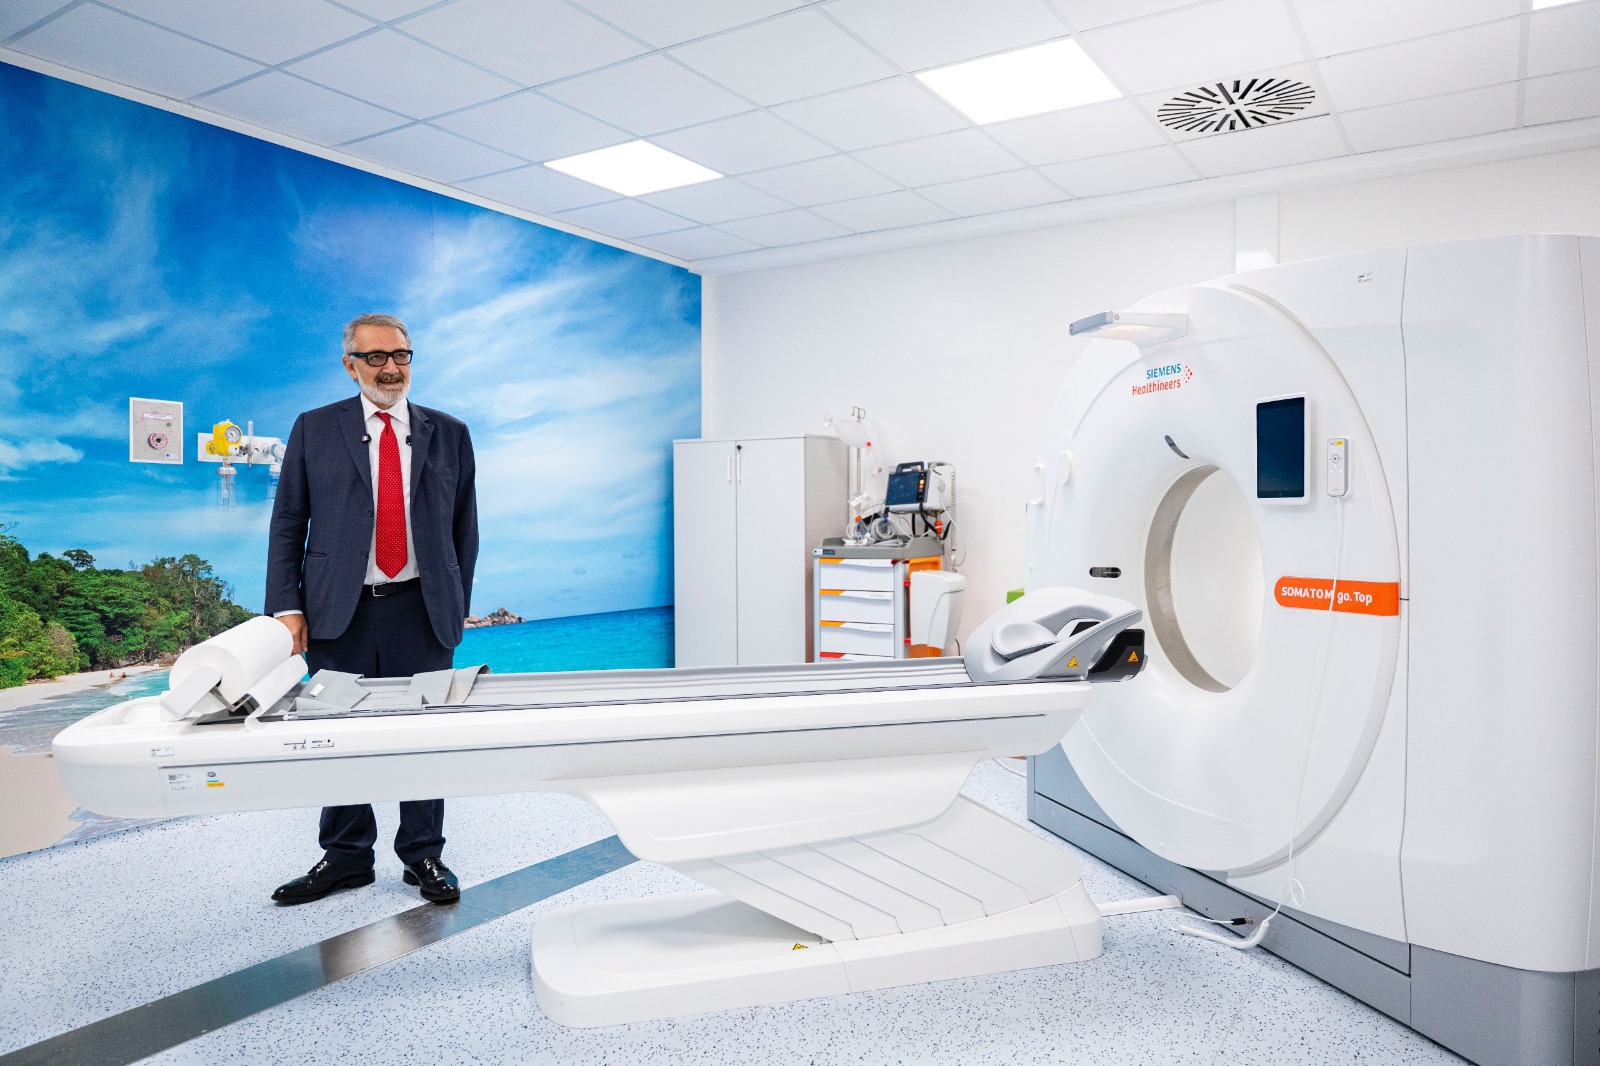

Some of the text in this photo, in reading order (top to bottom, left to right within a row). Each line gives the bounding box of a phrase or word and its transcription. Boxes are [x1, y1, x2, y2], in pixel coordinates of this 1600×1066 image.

[1146, 363, 1182, 380] SIEMENS
[1131, 379, 1182, 396] Healthineers
[1281, 586, 1373, 607] SOMATOM go. Top
